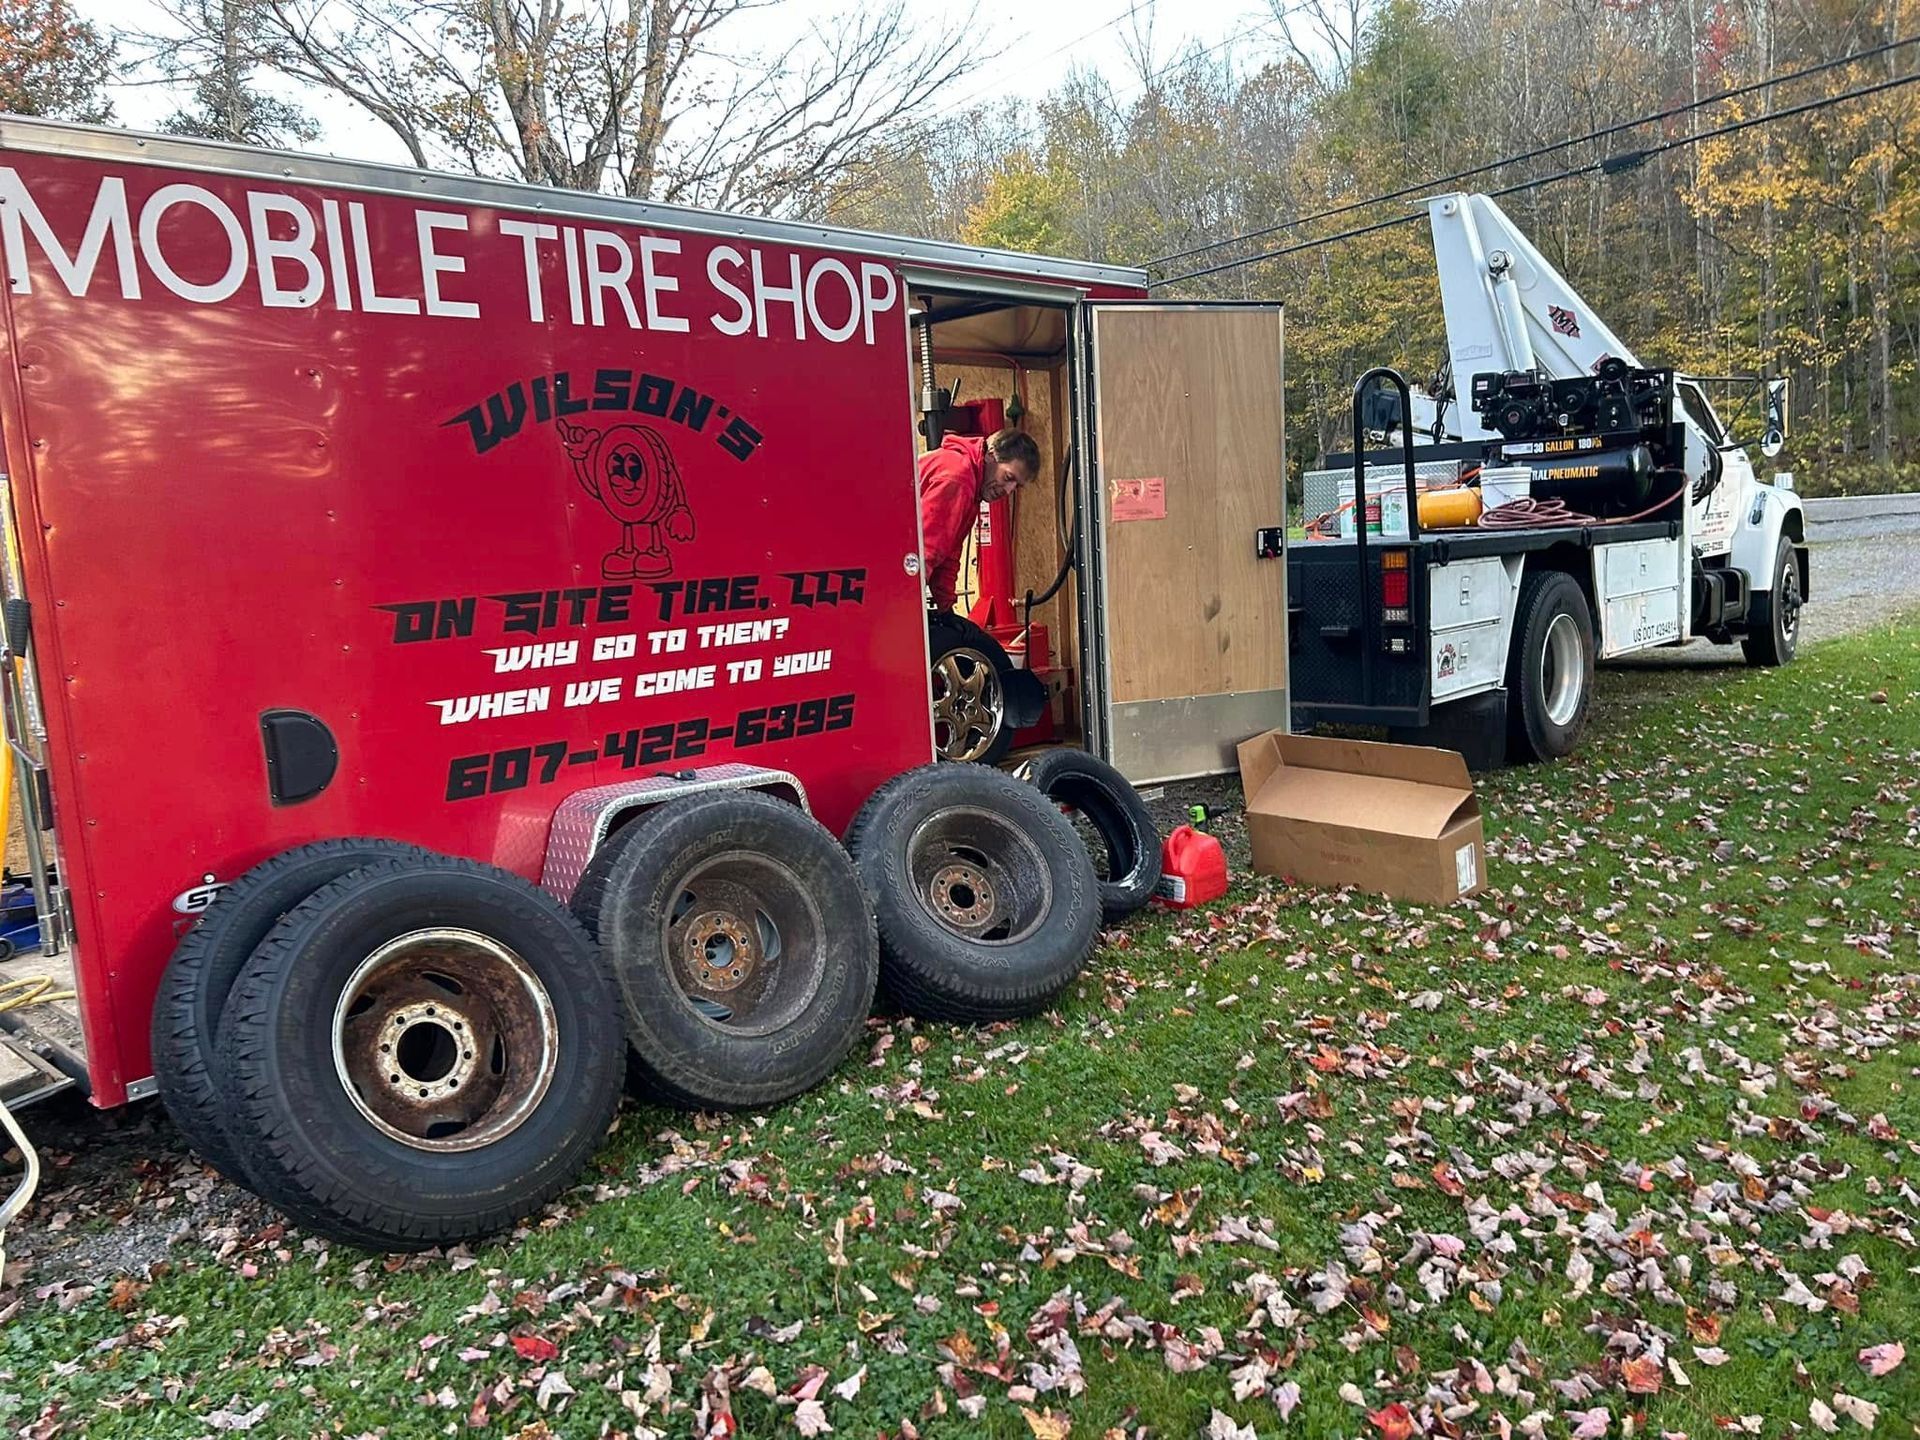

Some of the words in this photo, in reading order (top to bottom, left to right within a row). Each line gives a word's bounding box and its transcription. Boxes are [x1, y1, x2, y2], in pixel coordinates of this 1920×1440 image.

[0, 167, 481, 319] MOBILE
[499, 218, 690, 333] TIRE
[706, 246, 897, 345] SHOP
[1549, 306, 1581, 337] IMT
[441, 368, 764, 462] WILSON'S
[1545, 439, 1574, 452] GALLON
[372, 597, 476, 645] ON
[478, 584, 633, 637] SITE
[641, 575, 770, 623] TIRE,
[481, 640, 579, 673] WHY
[592, 634, 637, 661] GO
[647, 629, 687, 654] TO
[697, 617, 790, 649] THEM?
[426, 686, 551, 725] WHEN
[564, 677, 623, 707] WE
[634, 665, 717, 698] COME
[726, 659, 763, 684] TO
[772, 649, 832, 678] YOU!
[444, 693, 857, 802] 607-422-6395
